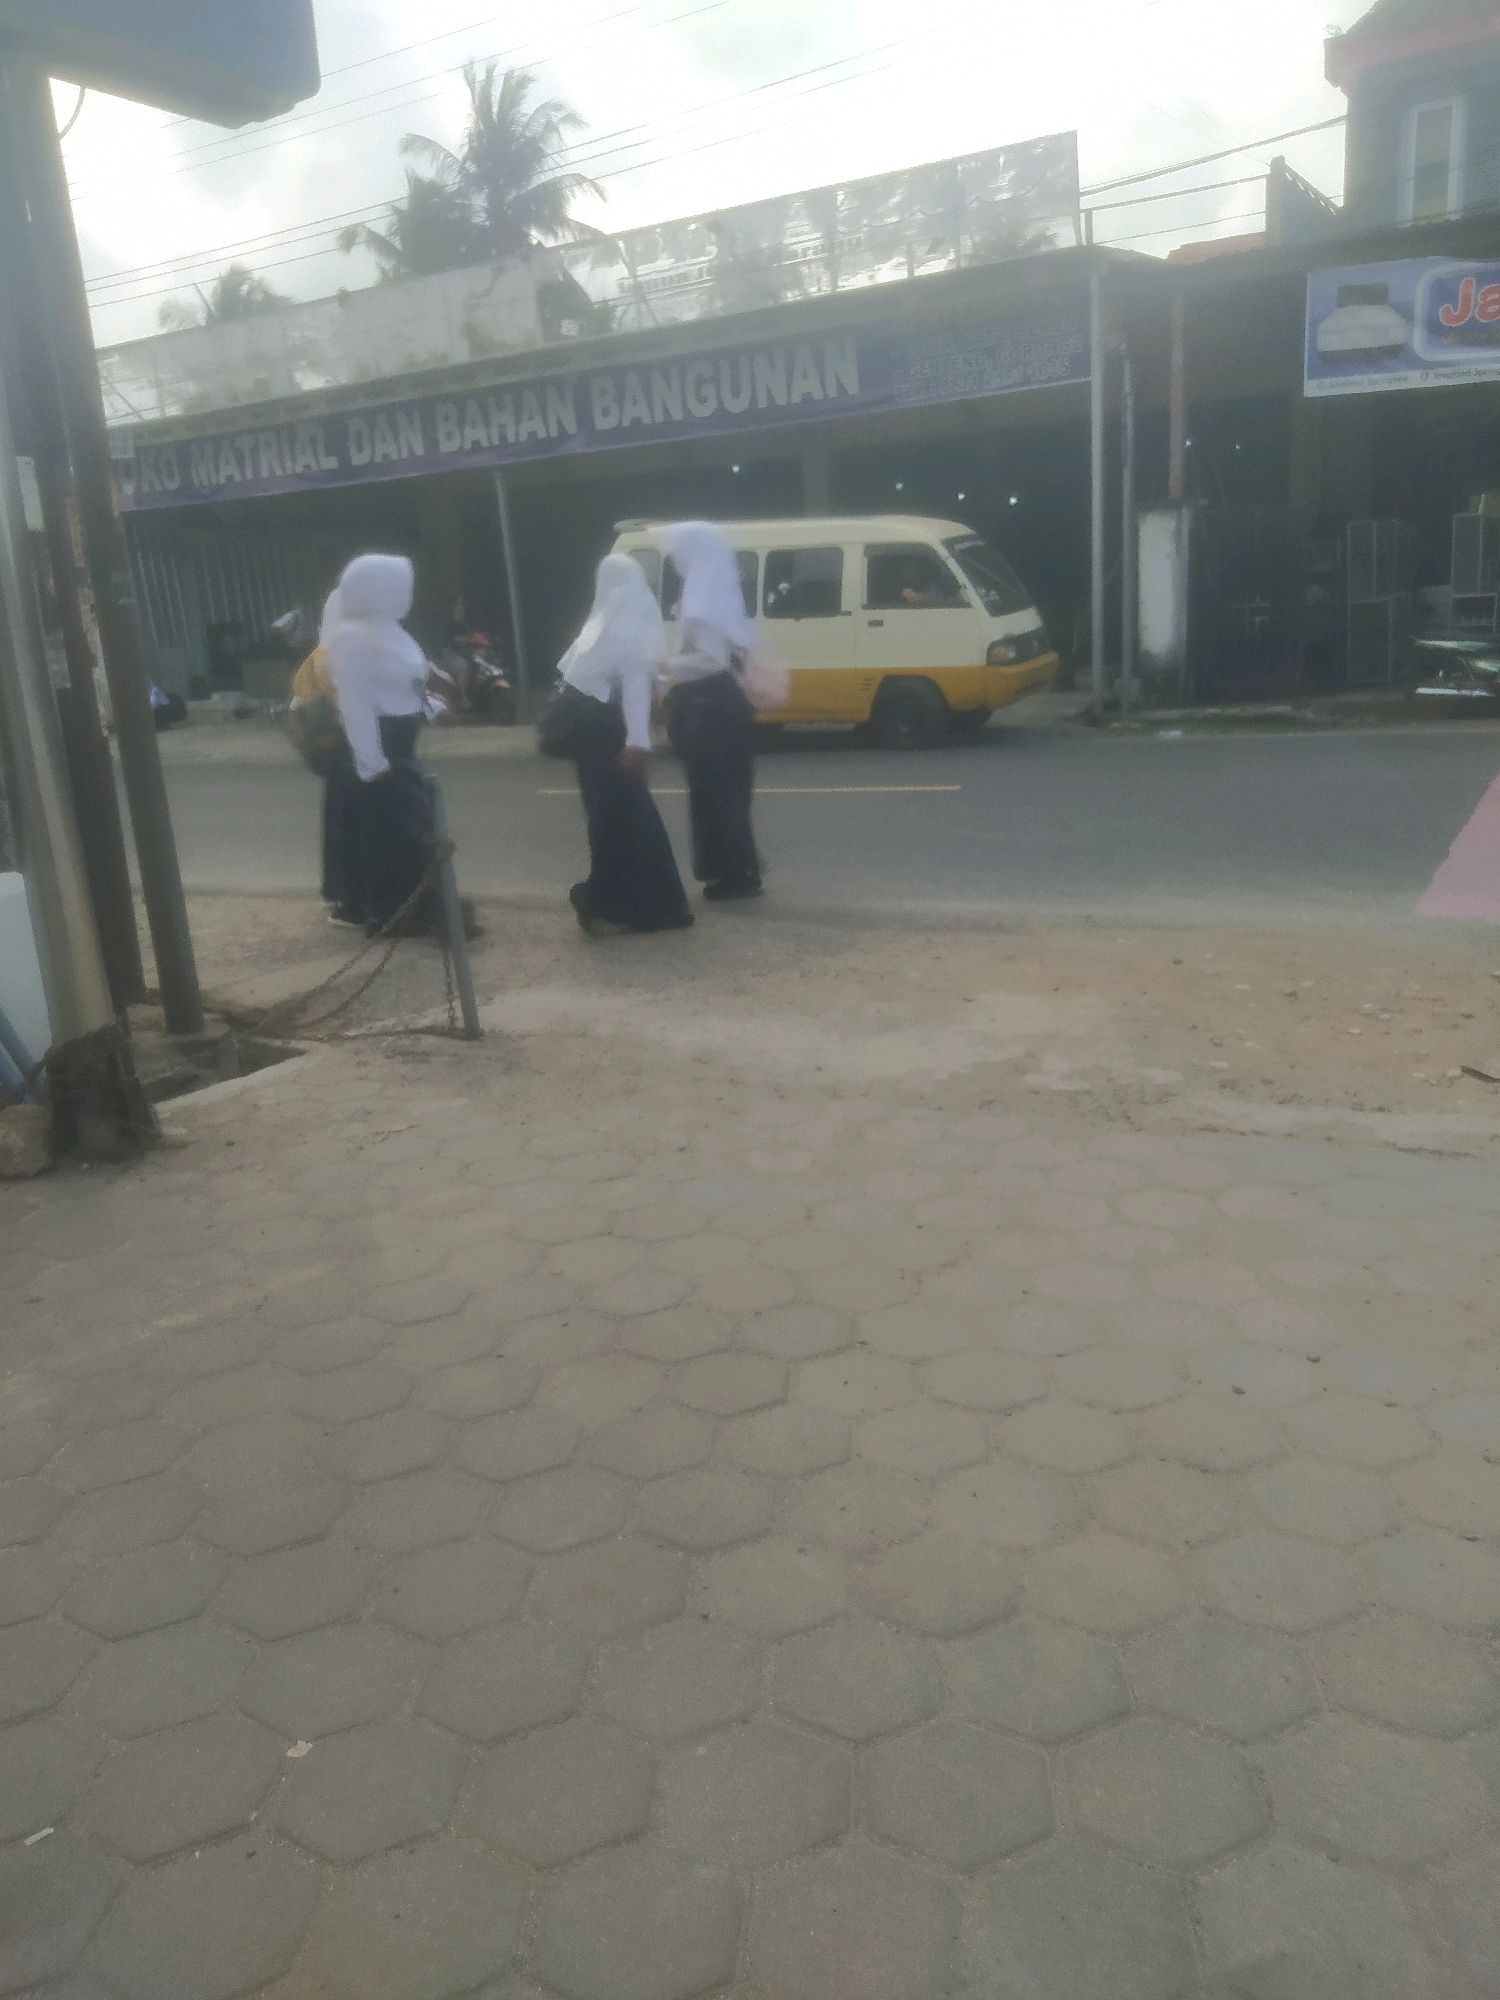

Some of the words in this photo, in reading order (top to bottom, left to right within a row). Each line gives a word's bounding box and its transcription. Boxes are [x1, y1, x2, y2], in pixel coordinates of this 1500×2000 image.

[190, 424, 340, 488] MATRIAL
[348, 406, 425, 467] DAN
[436, 379, 579, 454] BAHAN
[590, 335, 861, 431] BANGUNAN
